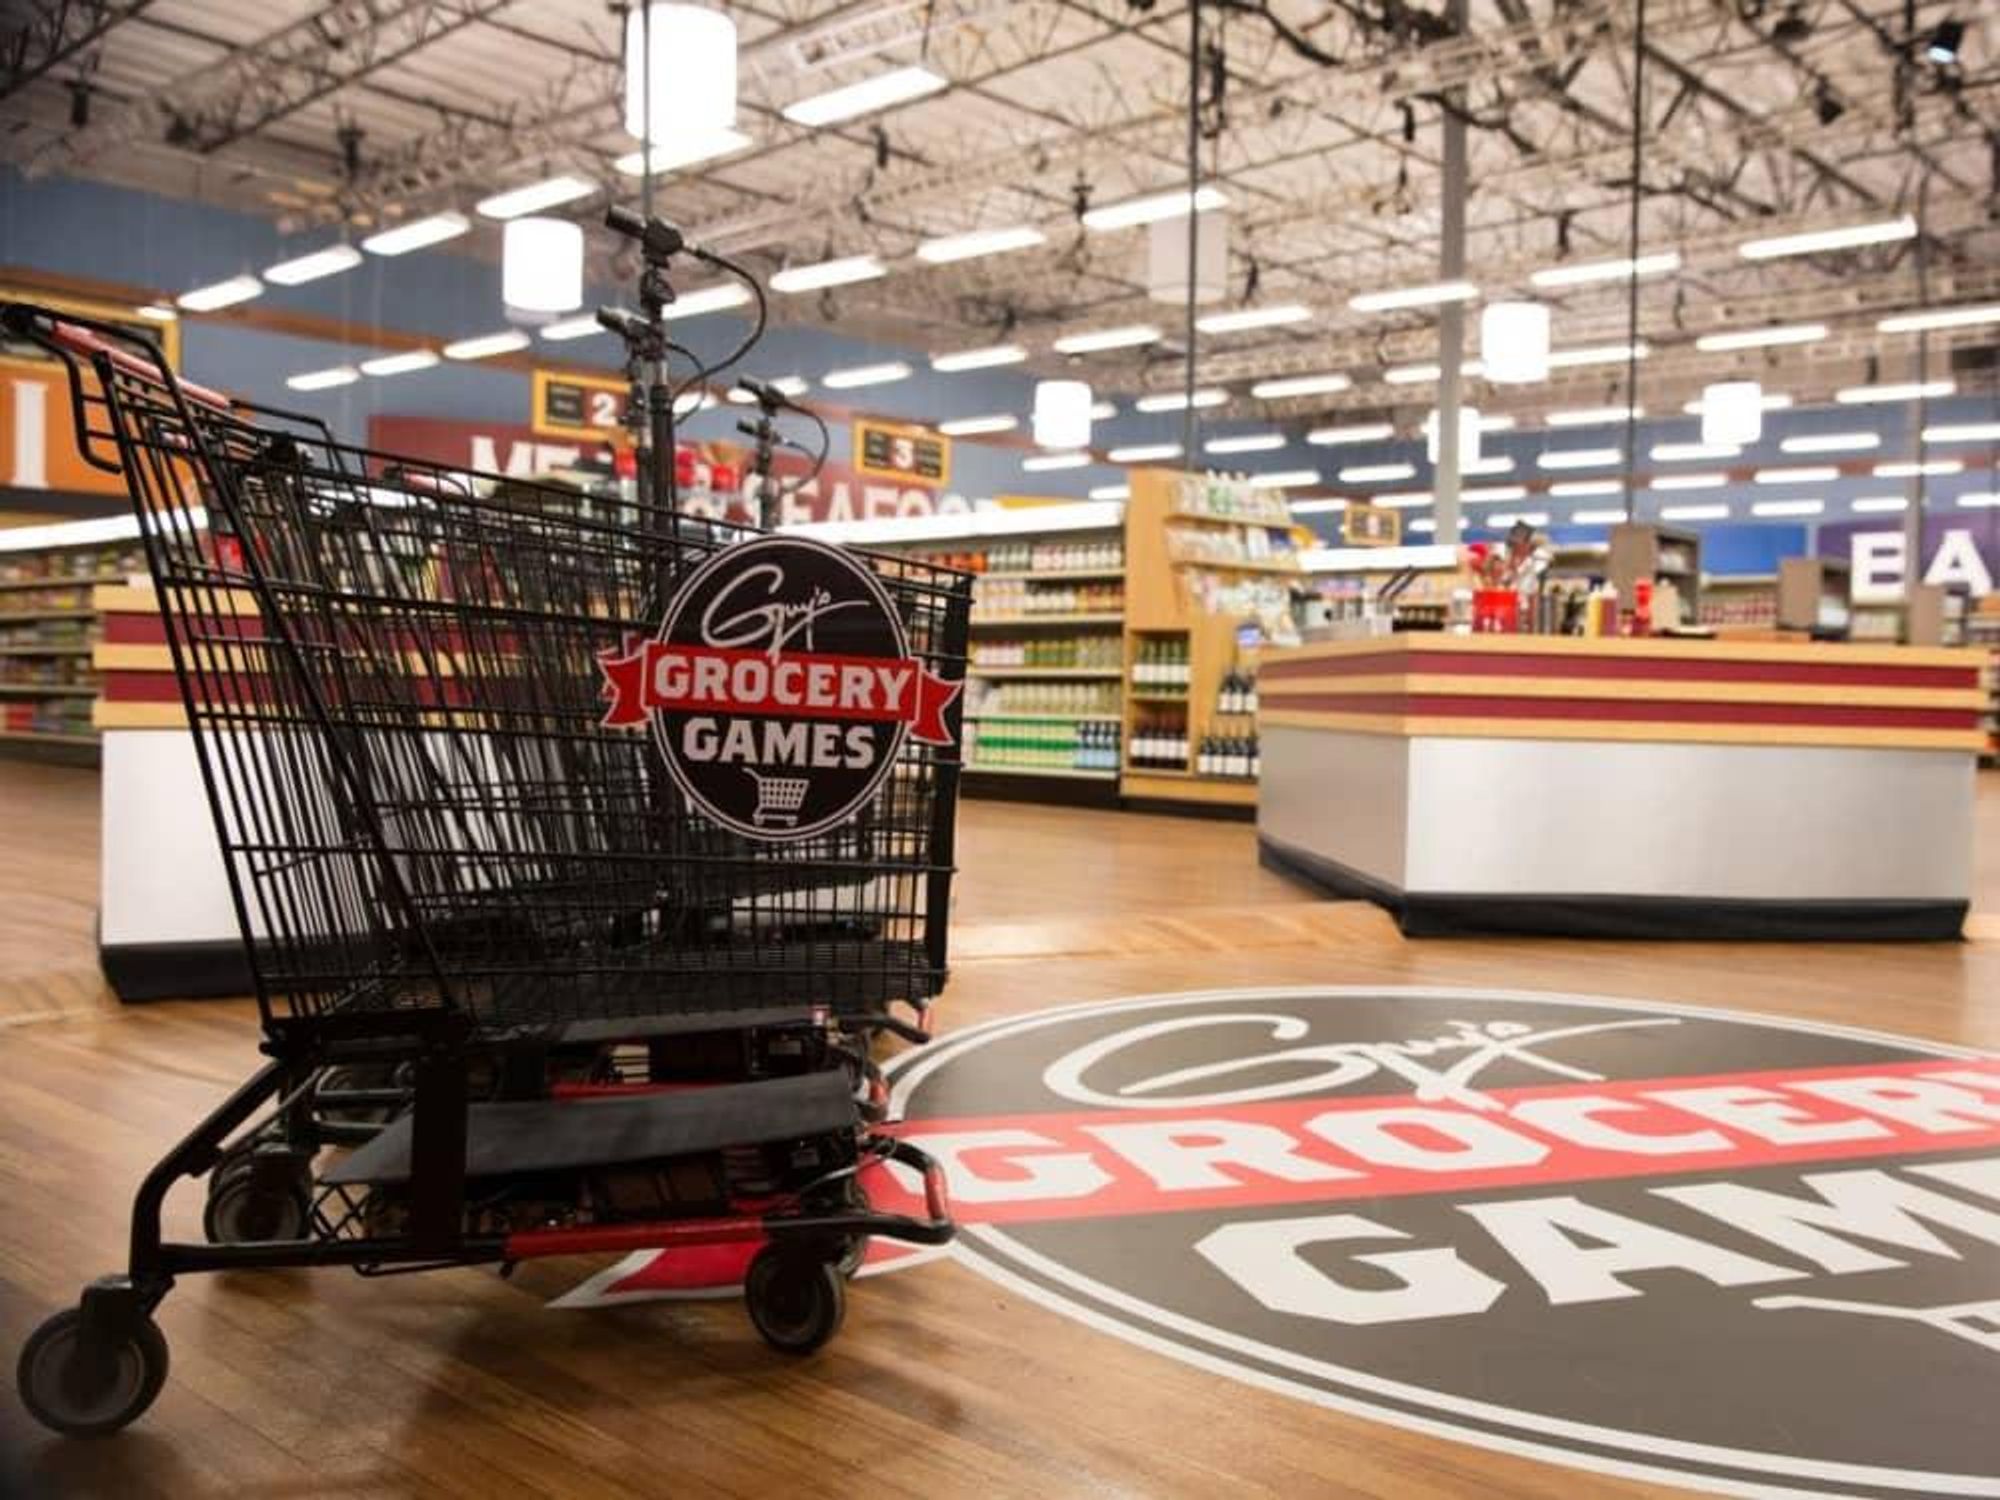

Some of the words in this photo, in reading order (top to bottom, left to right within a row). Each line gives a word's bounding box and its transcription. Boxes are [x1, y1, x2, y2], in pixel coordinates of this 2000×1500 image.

[592, 392, 618, 427] 2
[895, 438, 915, 470] 3
[701, 564, 870, 666] Guy's
[654, 653, 914, 712] GROCERY
[682, 717, 876, 770] GAMES
